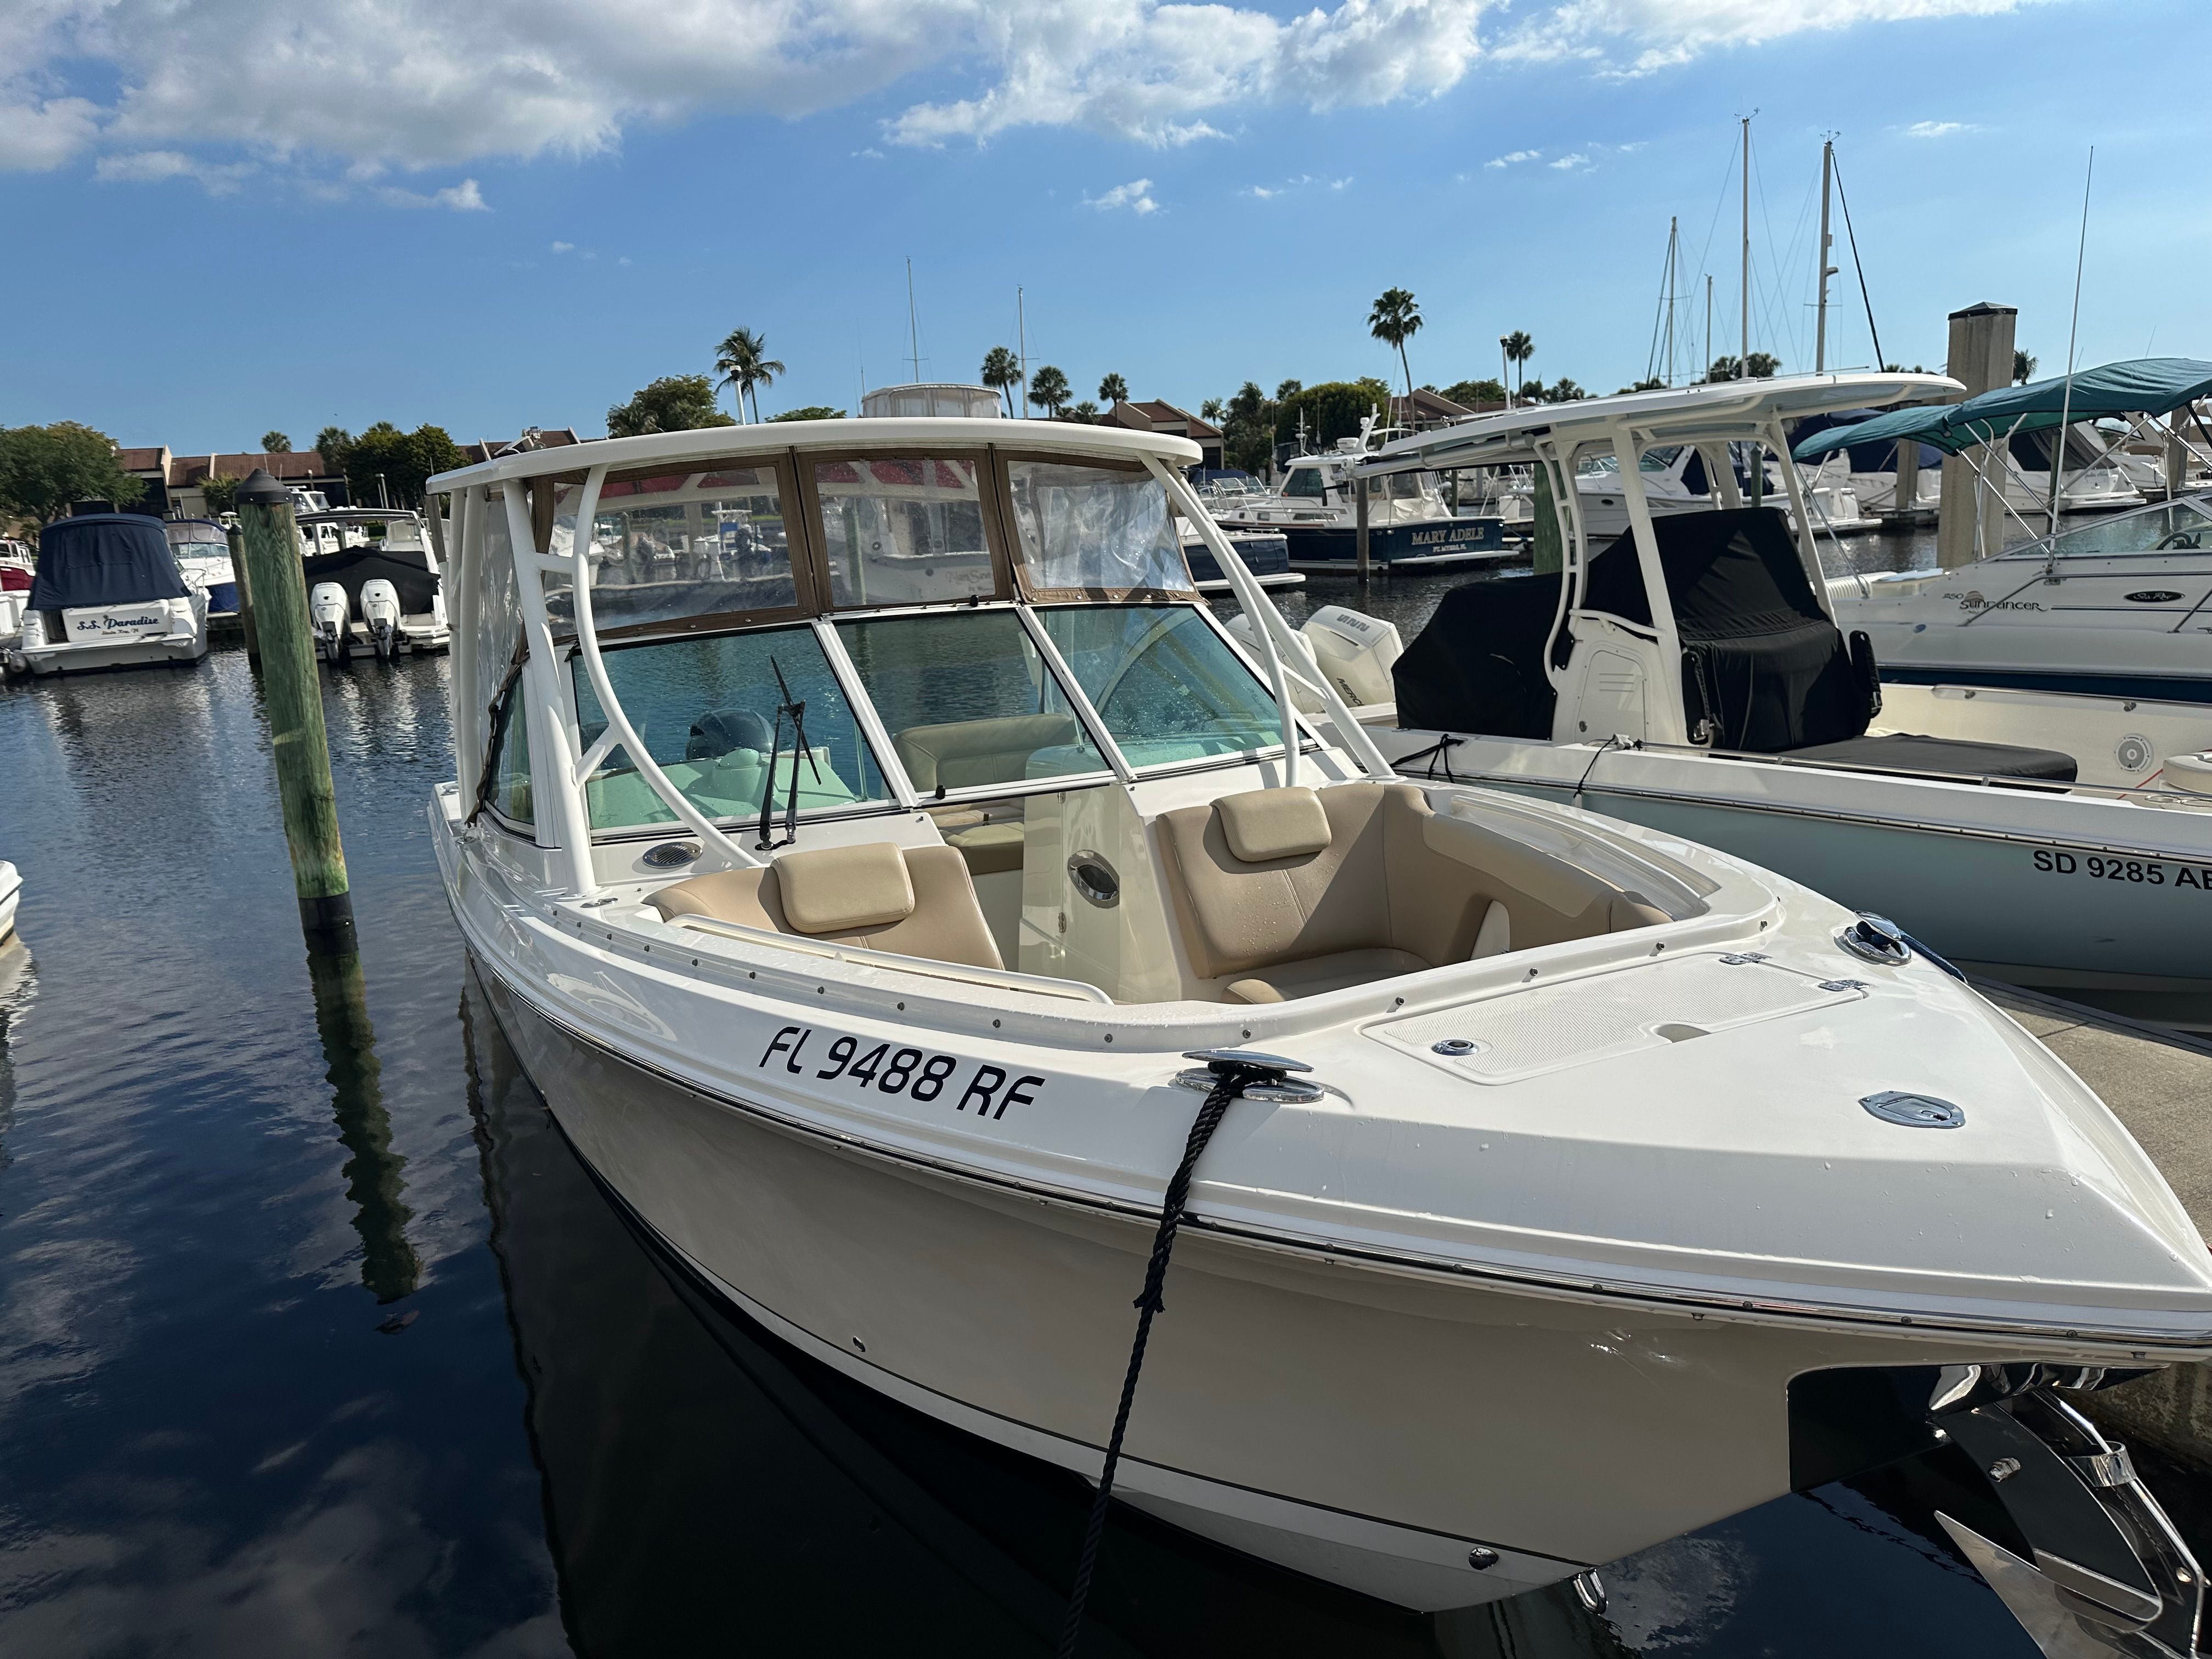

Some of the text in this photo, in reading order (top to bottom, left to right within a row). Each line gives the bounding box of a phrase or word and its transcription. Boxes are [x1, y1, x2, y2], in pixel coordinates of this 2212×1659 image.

[1412, 527, 1484, 545] MARY ADELE
[103, 616, 159, 629] Paradise
[2033, 850, 2078, 874] SD
[2086, 857, 2165, 885] 9285
[759, 1026, 1046, 1120] FL 9488 RF
